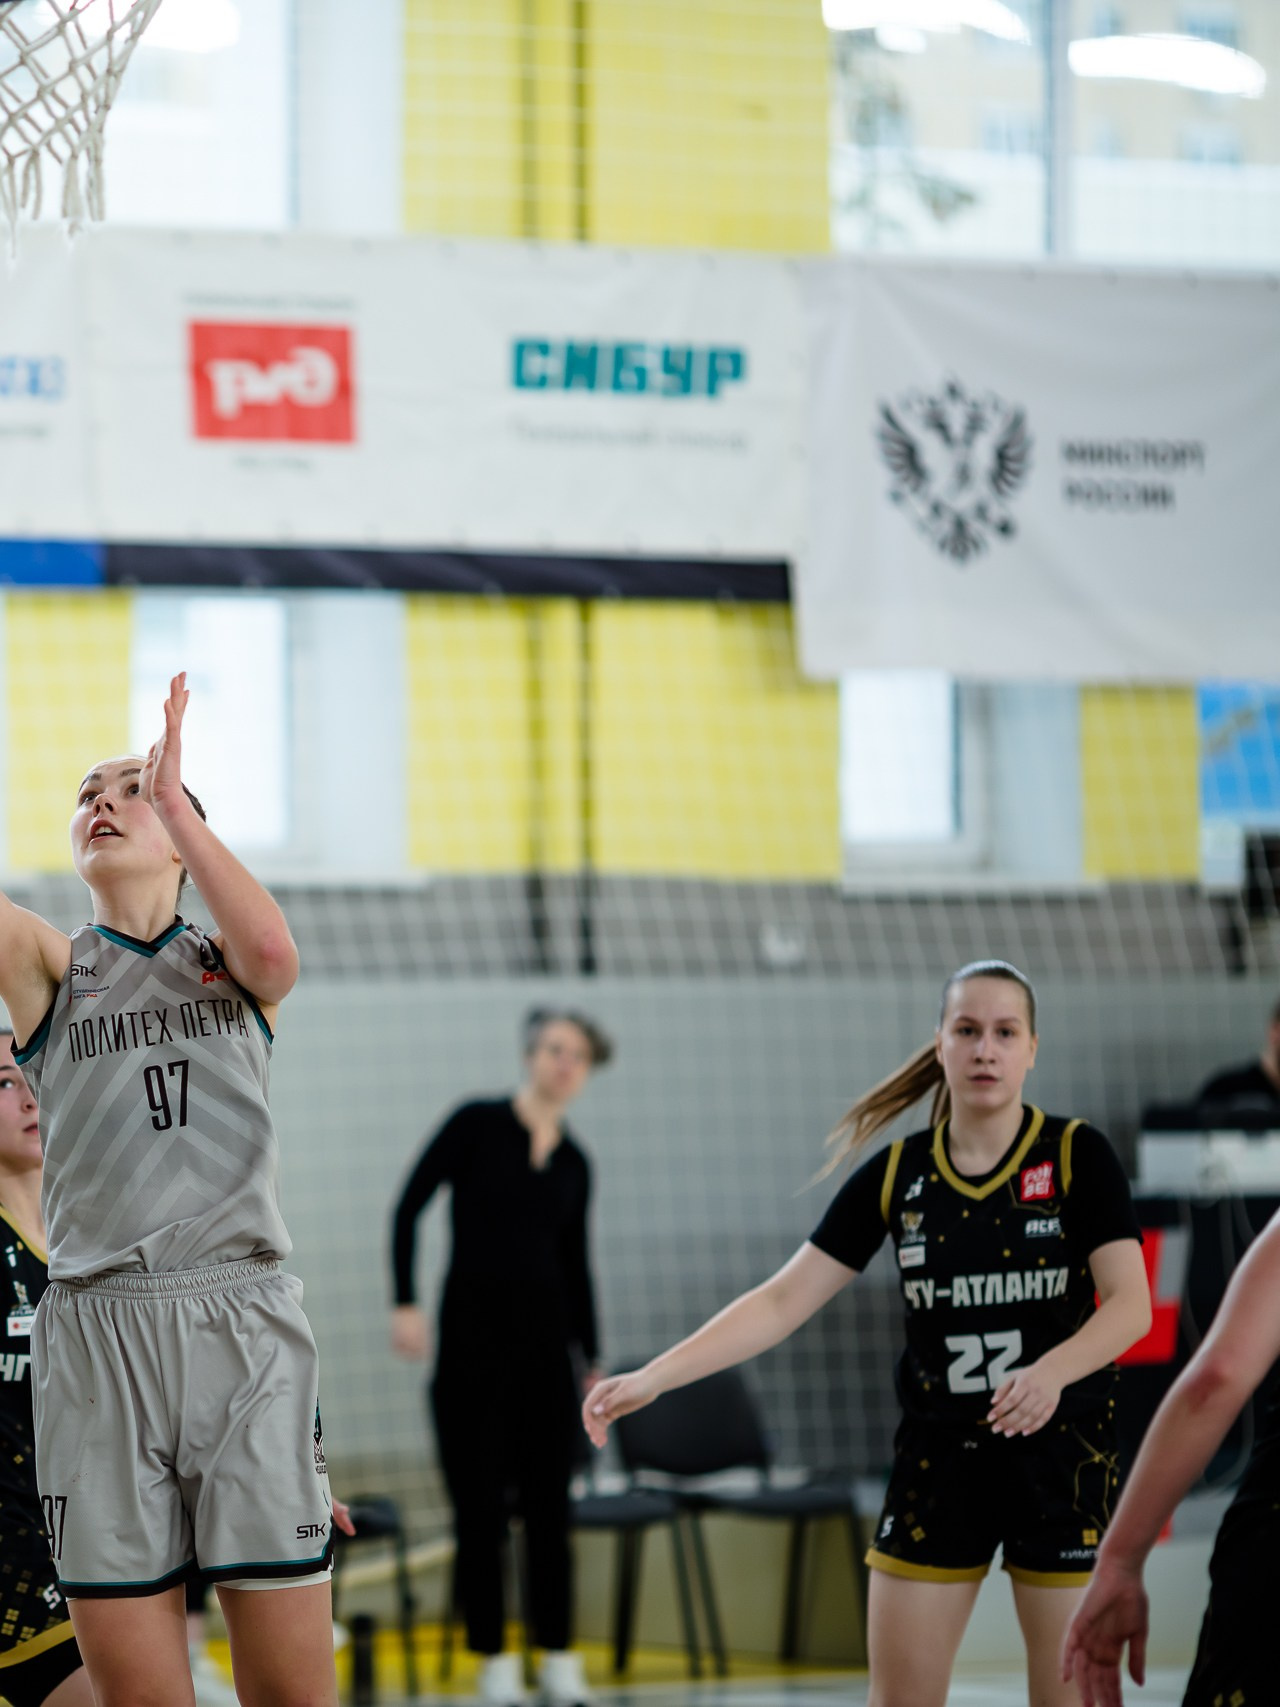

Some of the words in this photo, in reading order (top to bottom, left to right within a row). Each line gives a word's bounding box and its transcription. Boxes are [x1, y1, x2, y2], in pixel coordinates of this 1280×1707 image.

[514, 340, 746, 396] СИБУР
[68, 1008, 174, 1063] ПОЛИТЕХ
[179, 999, 250, 1040] ПЕТРА
[143, 1059, 190, 1132] 97
[945, 1328, 1023, 1394] 22
[296, 1522, 326, 1540] STK
